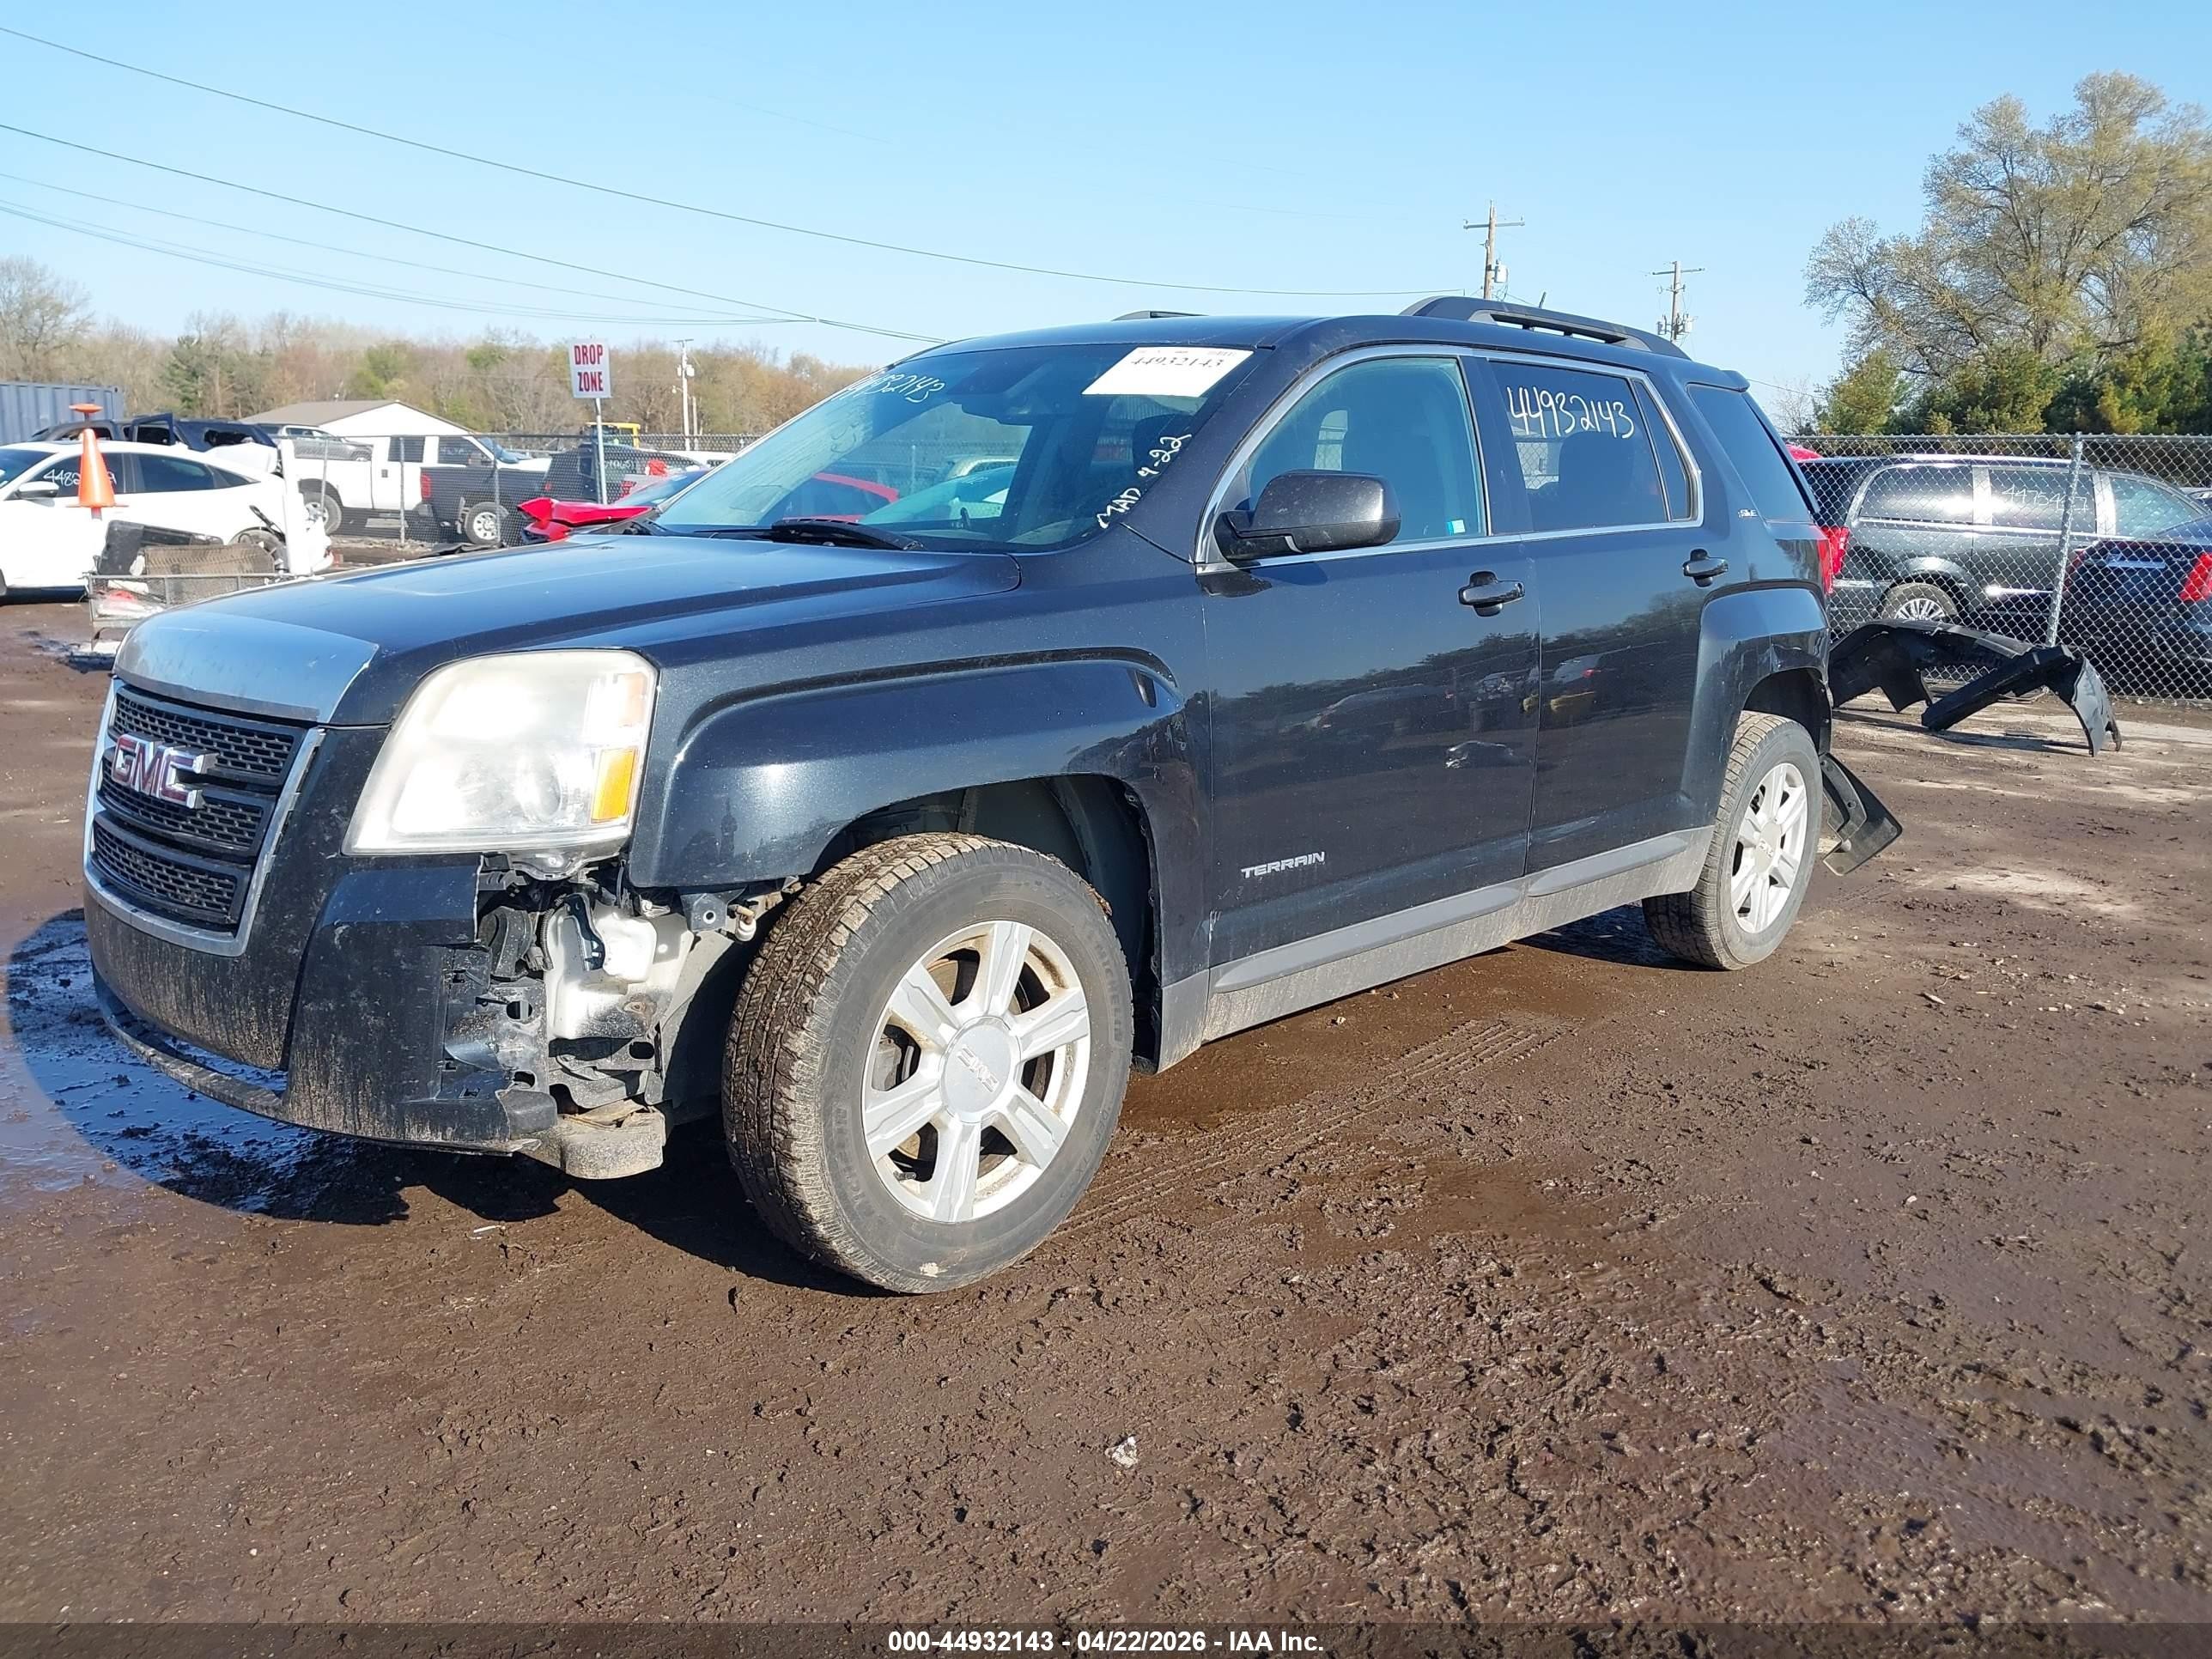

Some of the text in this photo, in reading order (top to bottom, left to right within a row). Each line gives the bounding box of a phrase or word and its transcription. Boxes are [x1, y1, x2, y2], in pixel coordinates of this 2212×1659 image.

[574, 344, 603, 365] DROP
[1131, 356, 1225, 368] 44932143
[577, 371, 604, 392] ZONE
[1506, 386, 1634, 438] 44932143
[1097, 488, 1141, 529] MAD
[112, 733, 216, 808] GMC
[1241, 851, 1325, 878] TERRAIN
